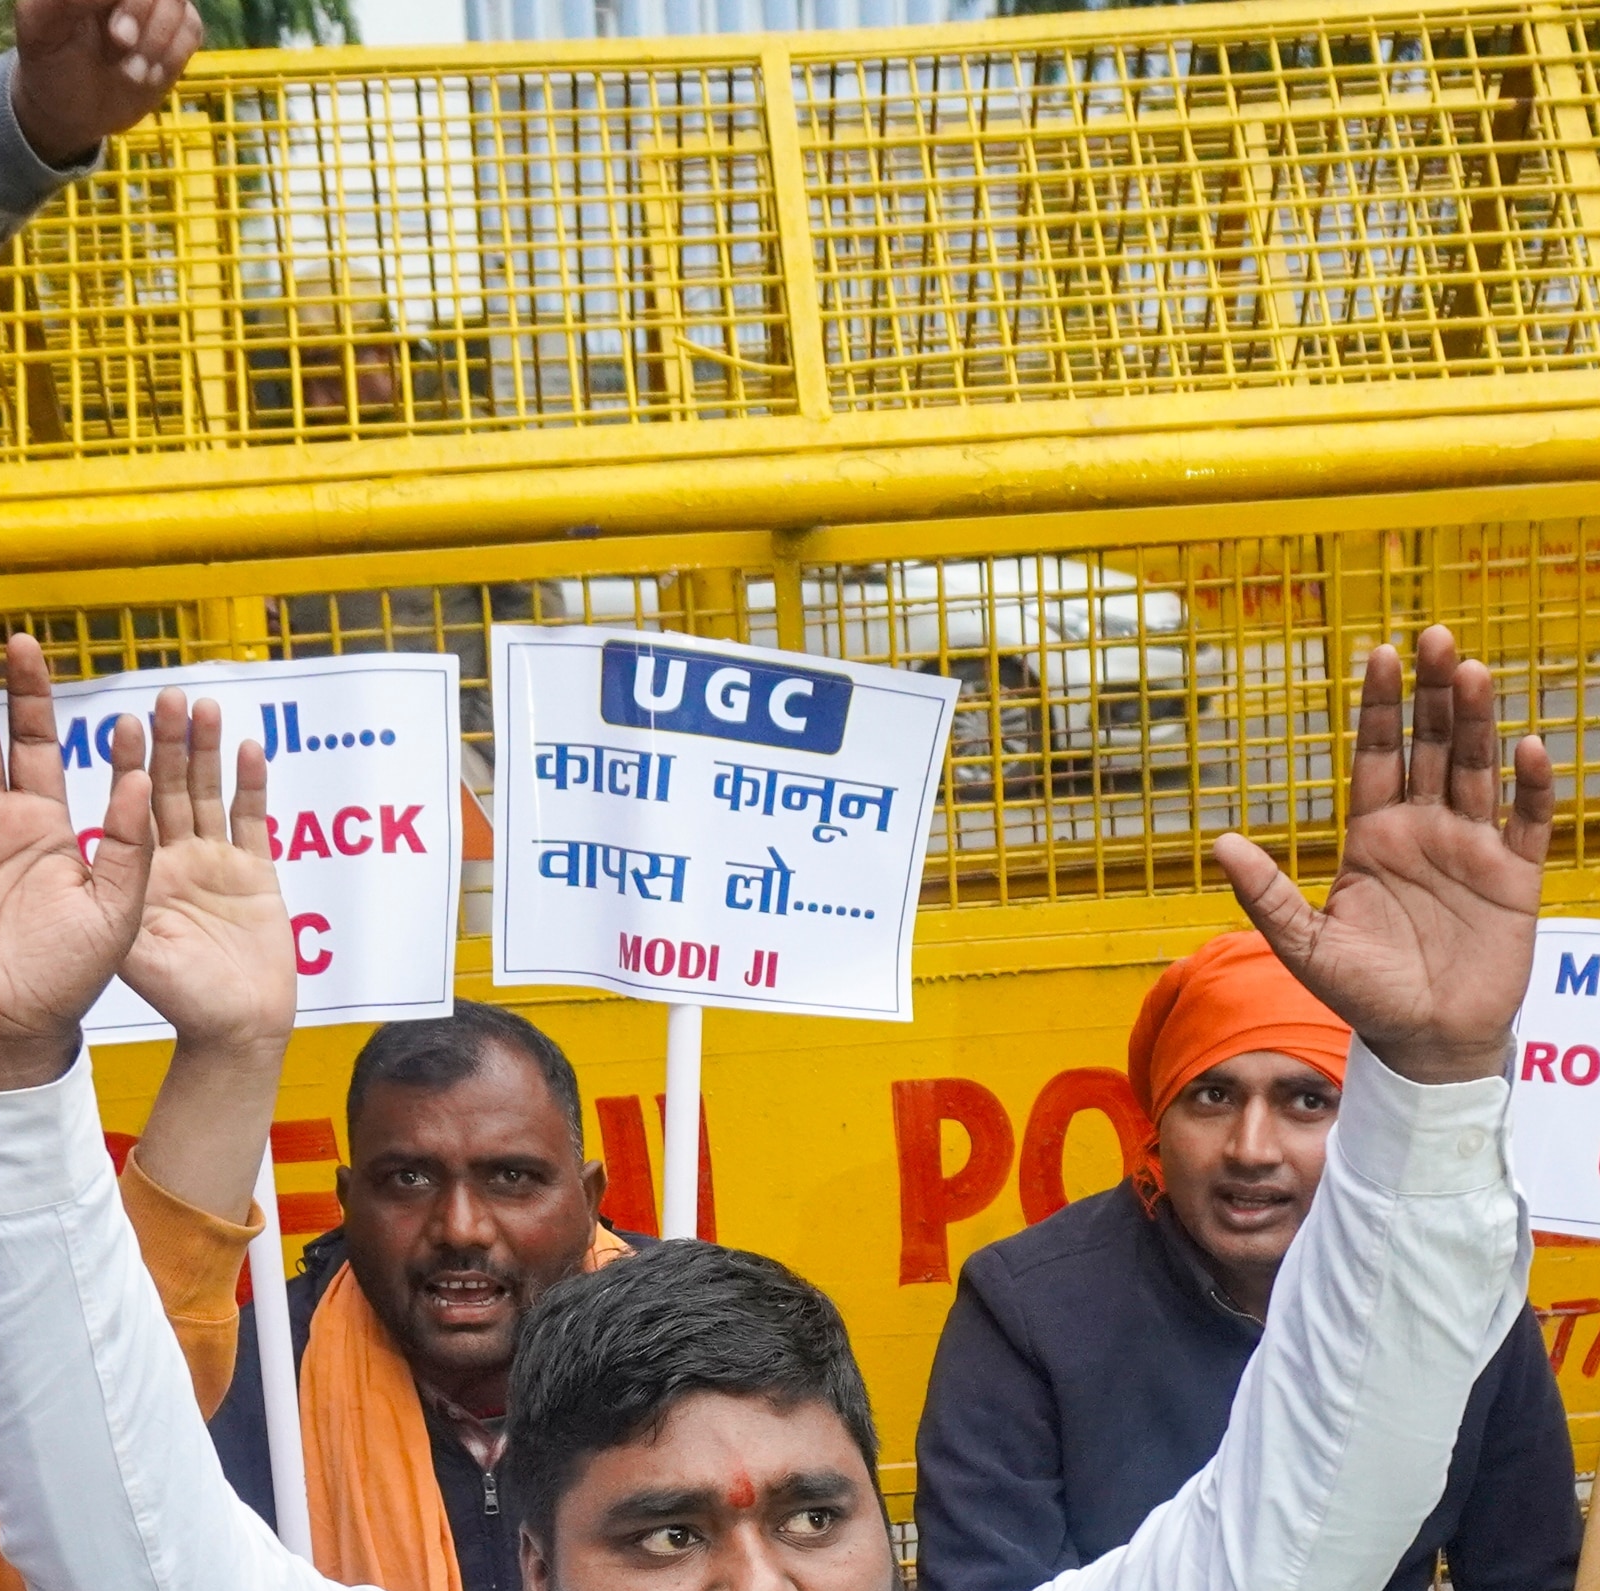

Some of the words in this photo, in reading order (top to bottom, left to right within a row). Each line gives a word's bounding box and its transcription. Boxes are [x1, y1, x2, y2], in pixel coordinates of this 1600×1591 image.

[535, 742, 677, 802] काला
[713, 760, 899, 843] कानून
[532, 839, 692, 903] वापस
[618, 932, 720, 982] MODI
[744, 950, 779, 988] JI
